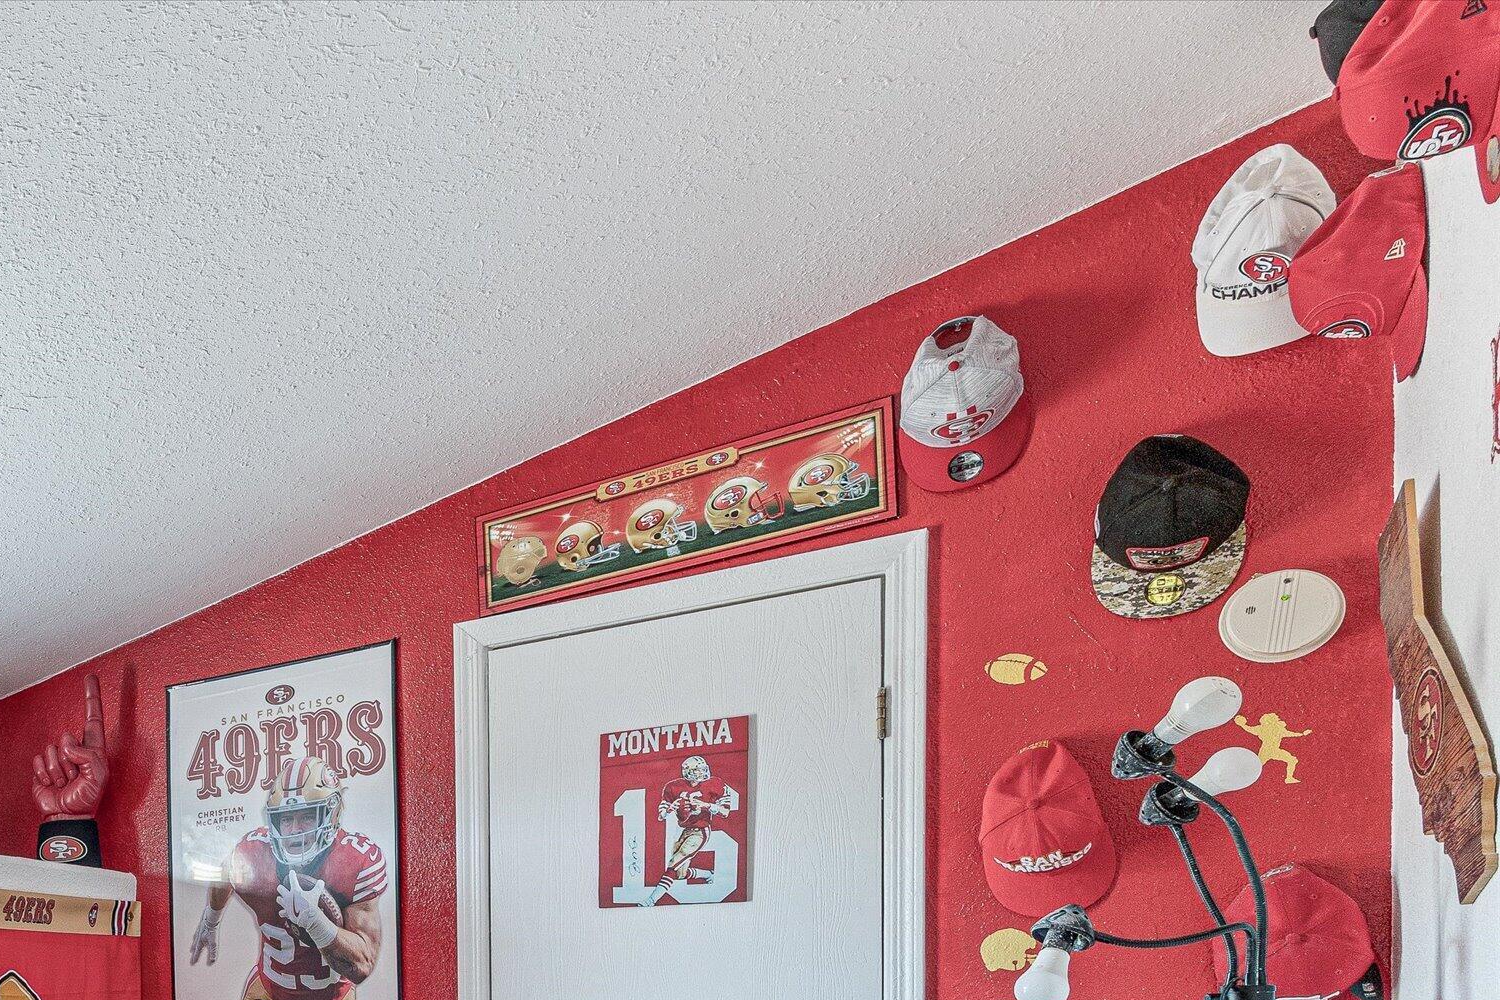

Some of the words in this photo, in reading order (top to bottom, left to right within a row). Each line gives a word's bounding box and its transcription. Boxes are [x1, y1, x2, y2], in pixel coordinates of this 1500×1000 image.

[1253, 256, 1283, 281] SF
[633, 464, 699, 489] 49ERS
[221, 713, 249, 726] SAN
[257, 694, 345, 718] FRANCISCO
[186, 700, 387, 800] 49ERS
[608, 718, 732, 758] MONTANA
[196, 814, 246, 828] McCAFFREY
[197, 806, 244, 819] CHRISTIAN
[49, 840, 78, 860] SF
[1019, 848, 1063, 866] SAN
[2, 894, 56, 925] 49ERS
